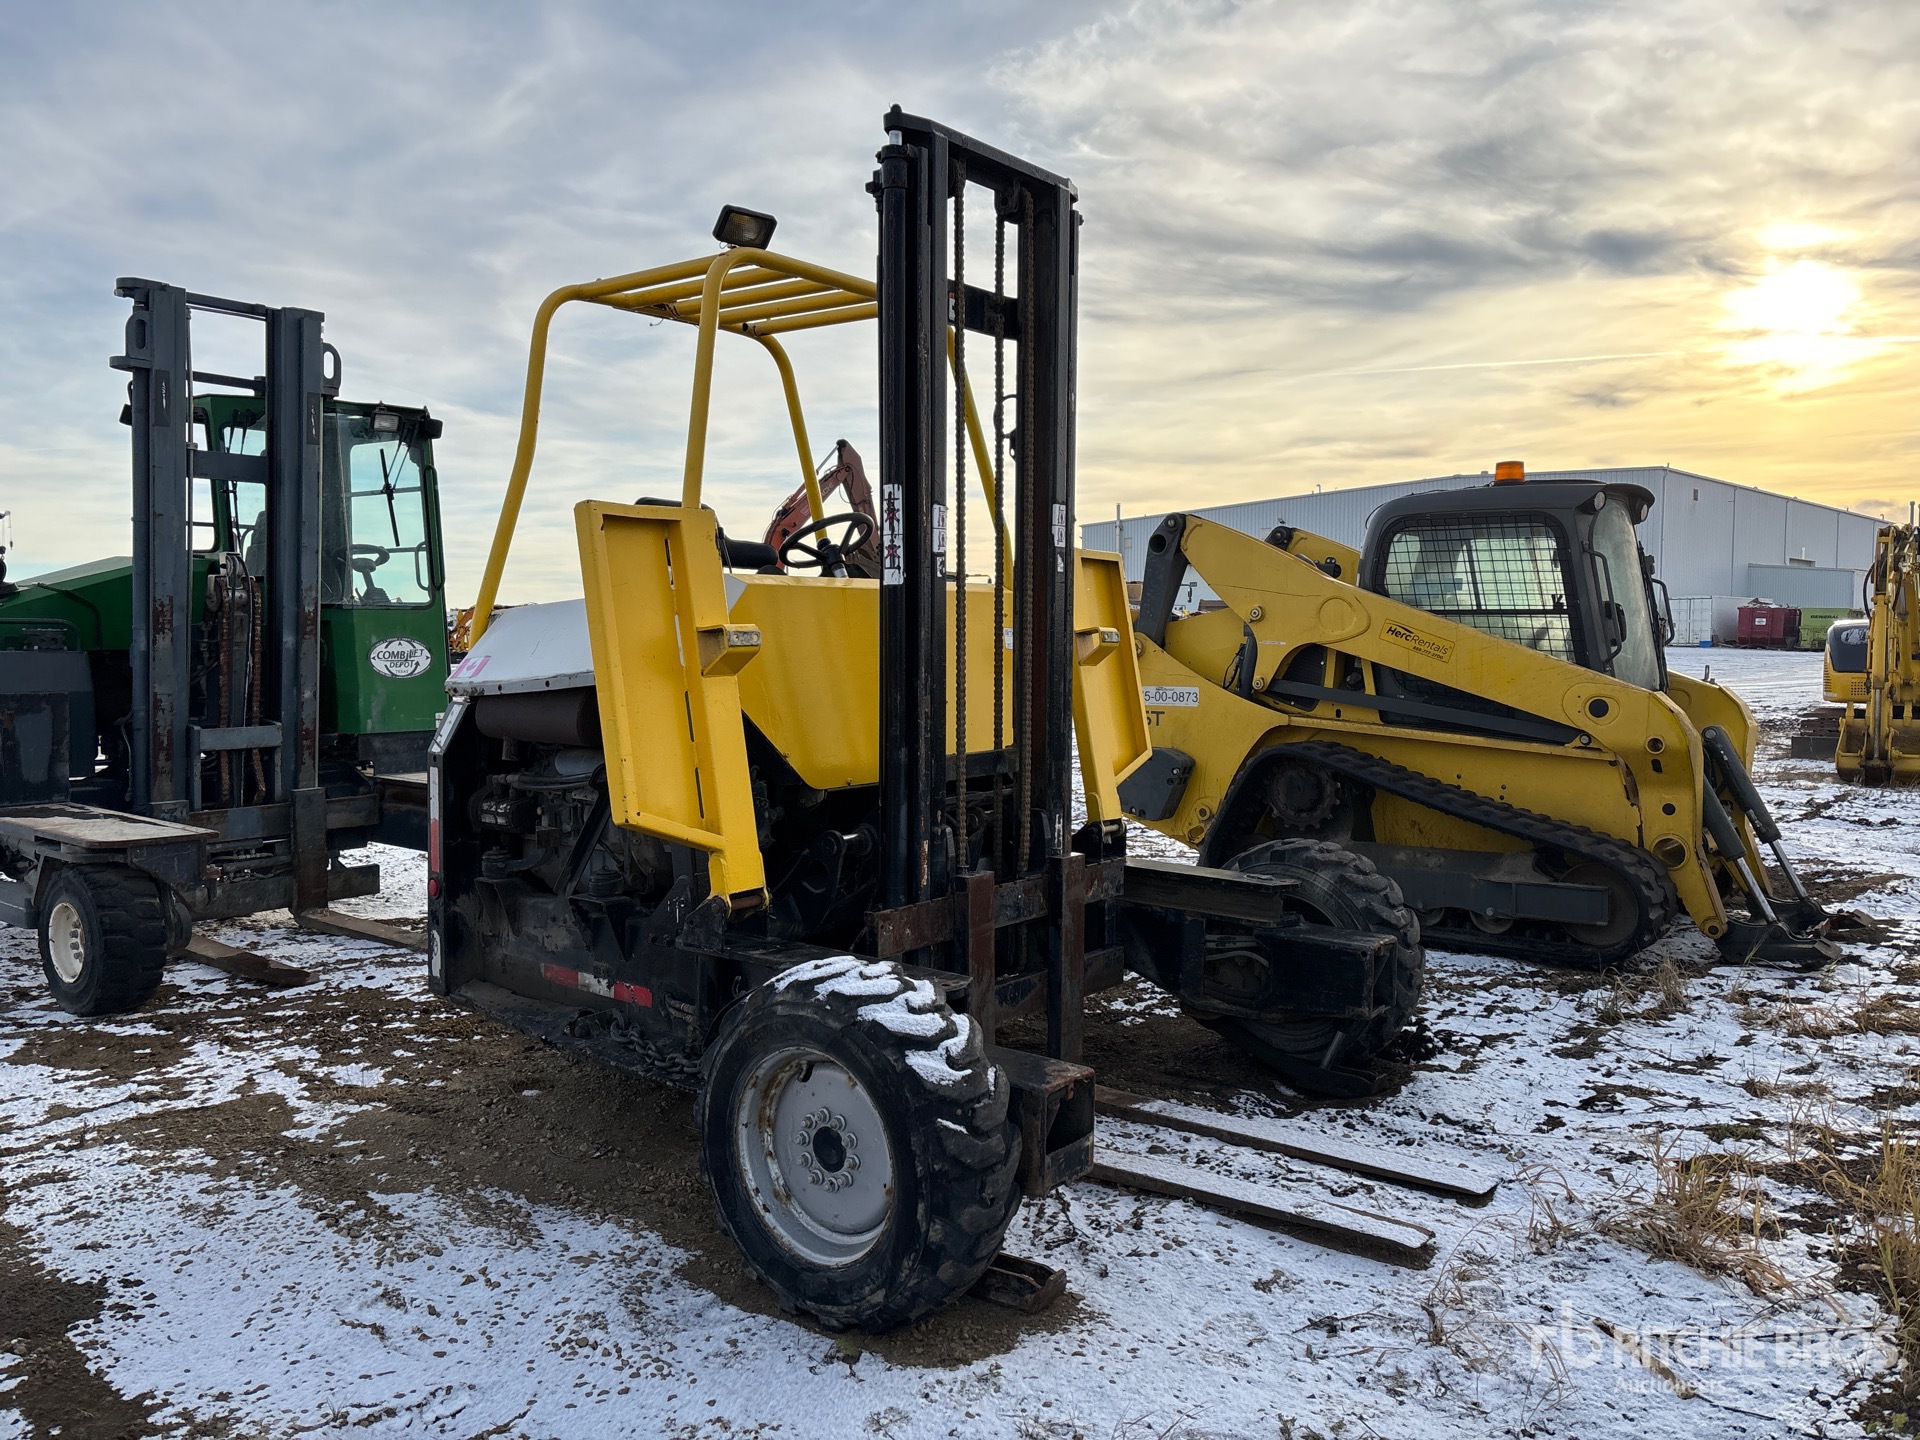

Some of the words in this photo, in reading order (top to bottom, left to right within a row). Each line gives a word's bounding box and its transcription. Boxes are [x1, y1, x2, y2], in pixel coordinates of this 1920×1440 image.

[1386, 626, 1449, 655] HercRentals
[389, 660, 414, 668] DEPOT
[1142, 690, 1199, 703] 5-00-0873
